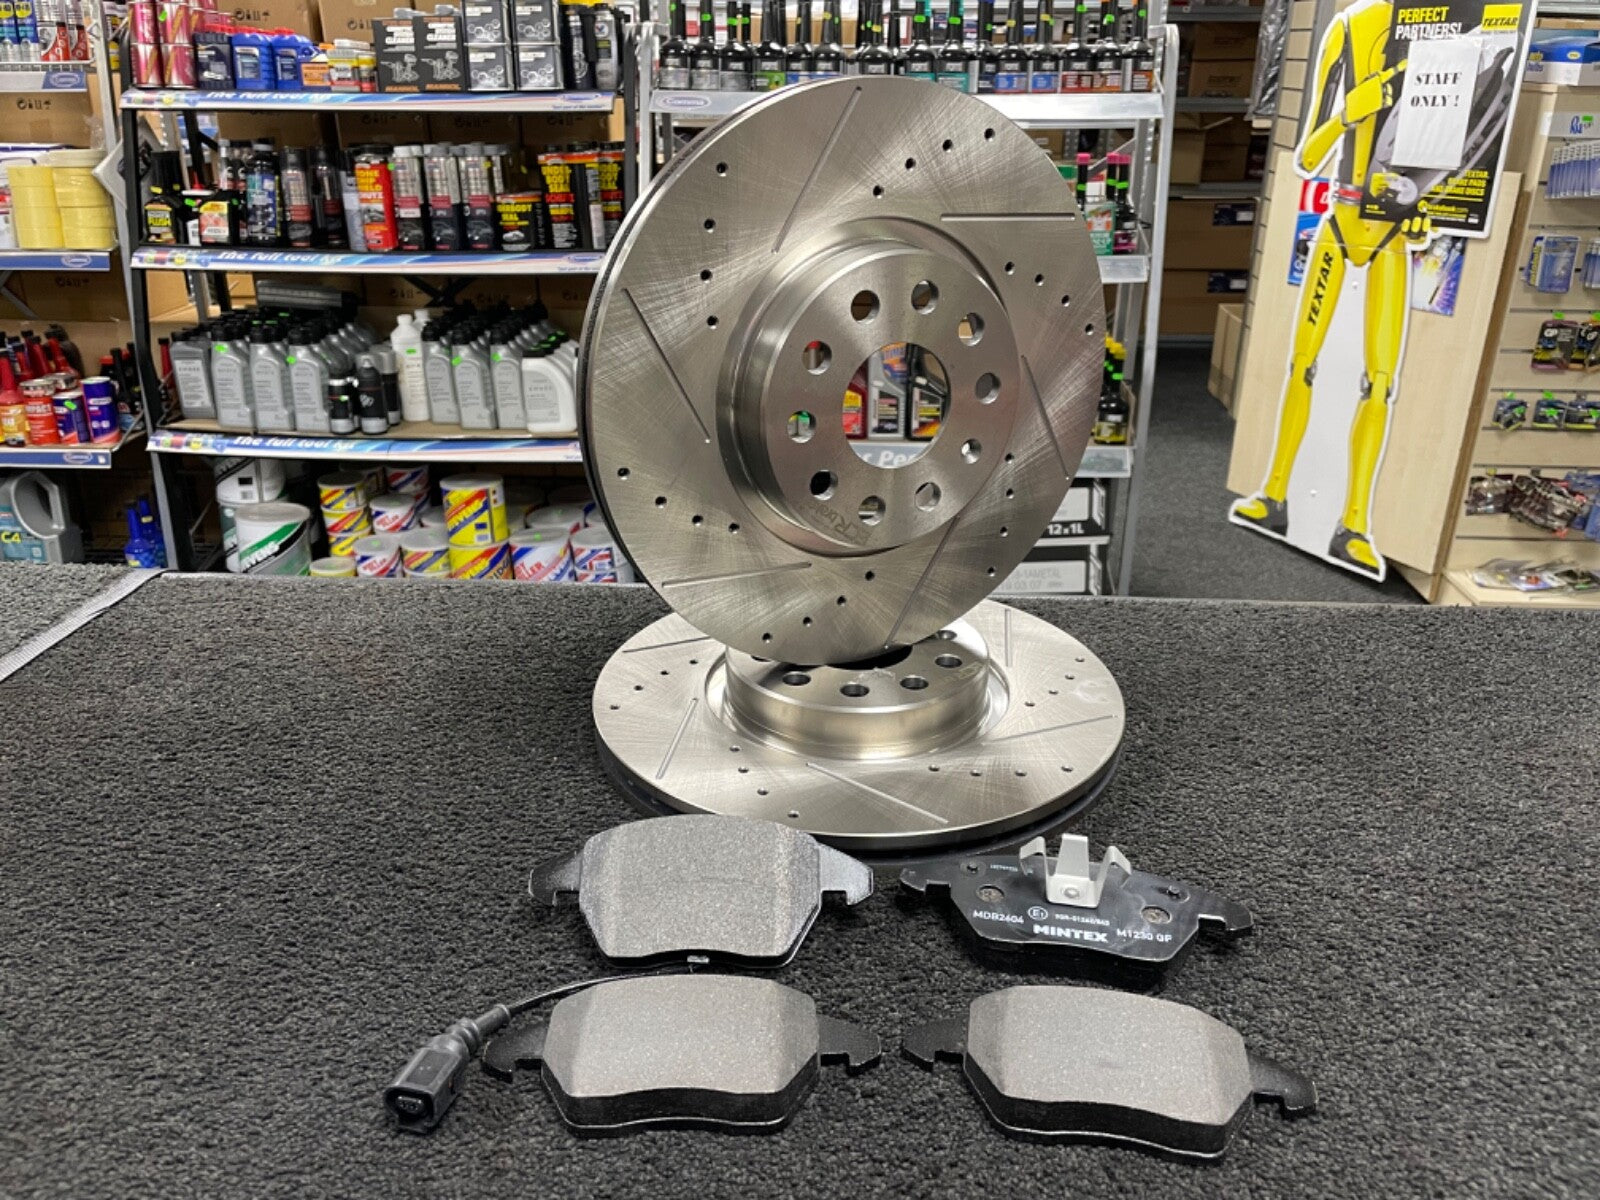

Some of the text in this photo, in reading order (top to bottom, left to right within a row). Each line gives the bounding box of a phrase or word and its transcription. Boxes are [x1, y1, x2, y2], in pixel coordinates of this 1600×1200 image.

[1397, 6, 1450, 23] PERFECT
[1483, 17, 1519, 27] TEXTAR
[1395, 22, 1462, 40] PARTNERS!
[1414, 72, 1462, 86] STAFF
[1411, 94, 1451, 107] ONLY
[218, 250, 248, 259] The
[250, 251, 283, 261] full
[284, 253, 320, 261] tool
[1308, 251, 1333, 326] TEXTAR
[233, 436, 263, 445] The
[265, 436, 297, 447] full
[1, 531, 21, 544] C4
[1033, 924, 1108, 943] MINTEX
